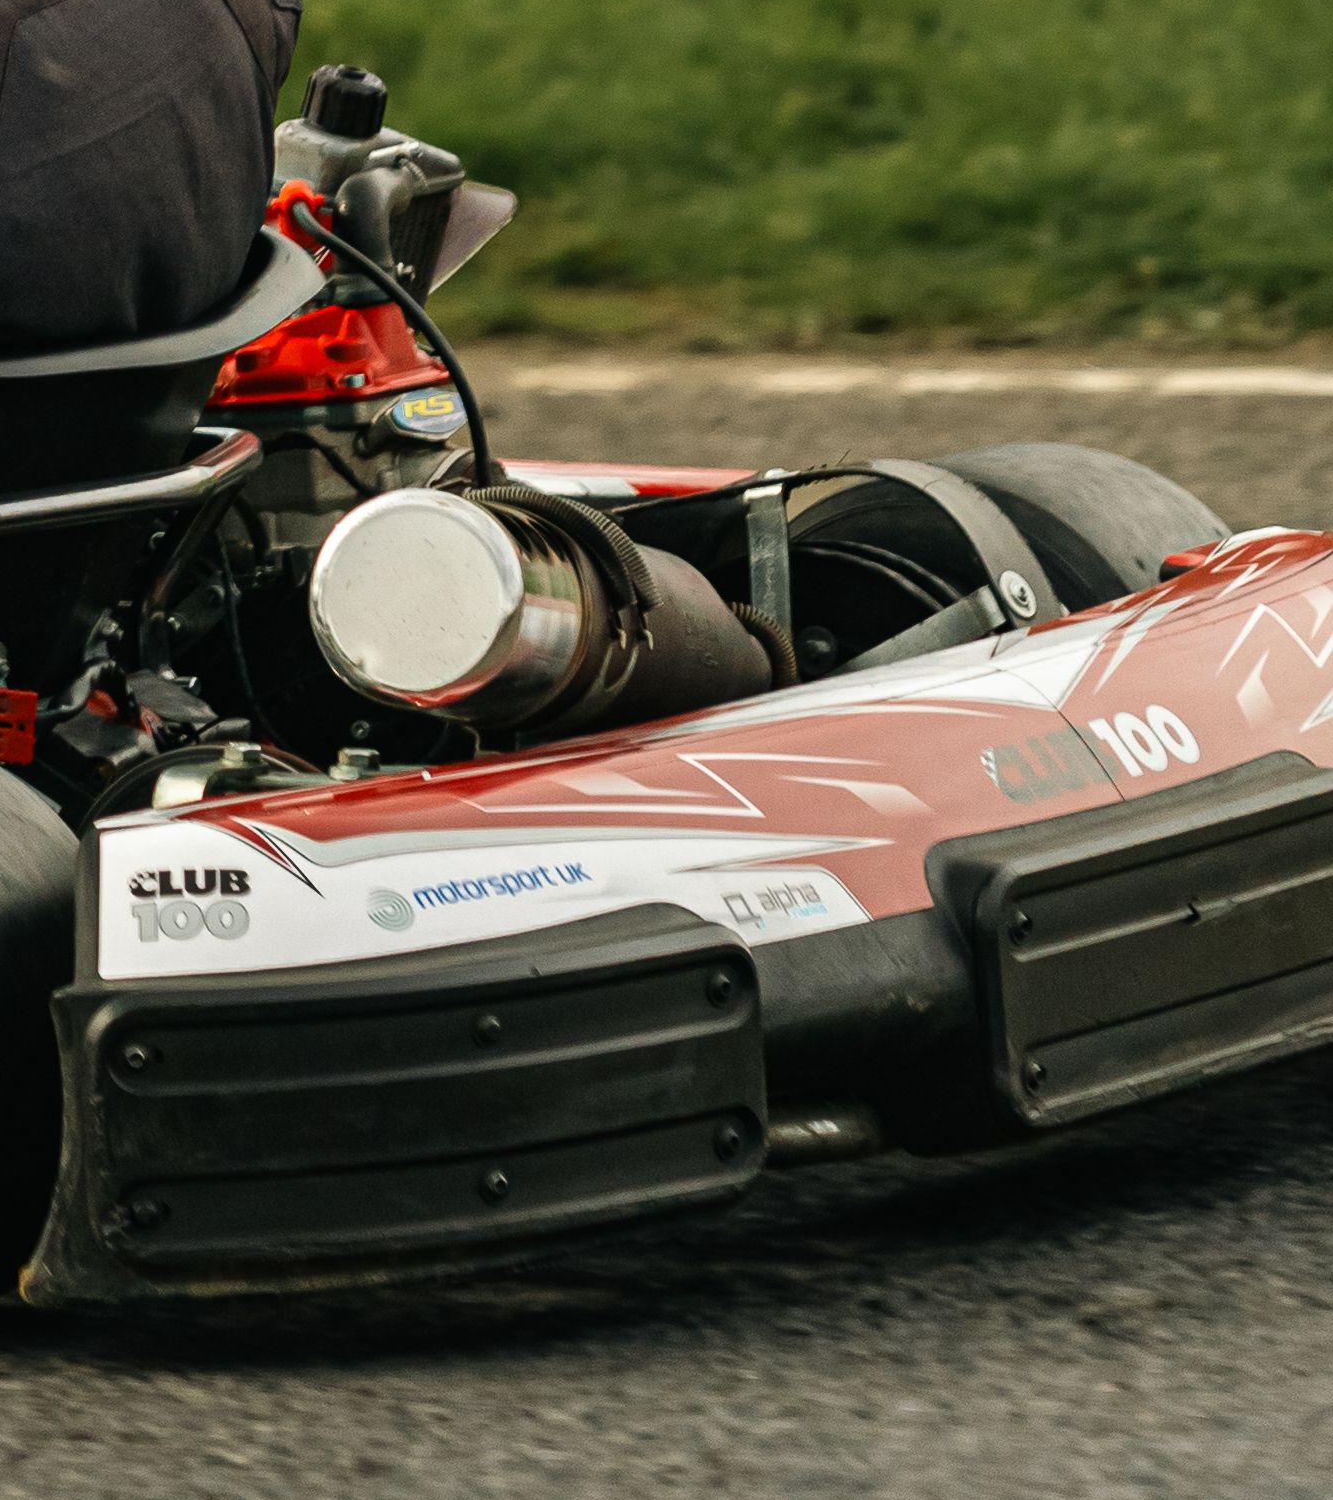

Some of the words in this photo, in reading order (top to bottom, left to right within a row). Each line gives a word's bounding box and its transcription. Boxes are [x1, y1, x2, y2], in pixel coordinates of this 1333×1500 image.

[404, 394, 454, 419] RS
[128, 868, 251, 898] CLUB
[411, 864, 558, 911] motorsport
[753, 880, 822, 916] alpha
[132, 900, 251, 943] 100
